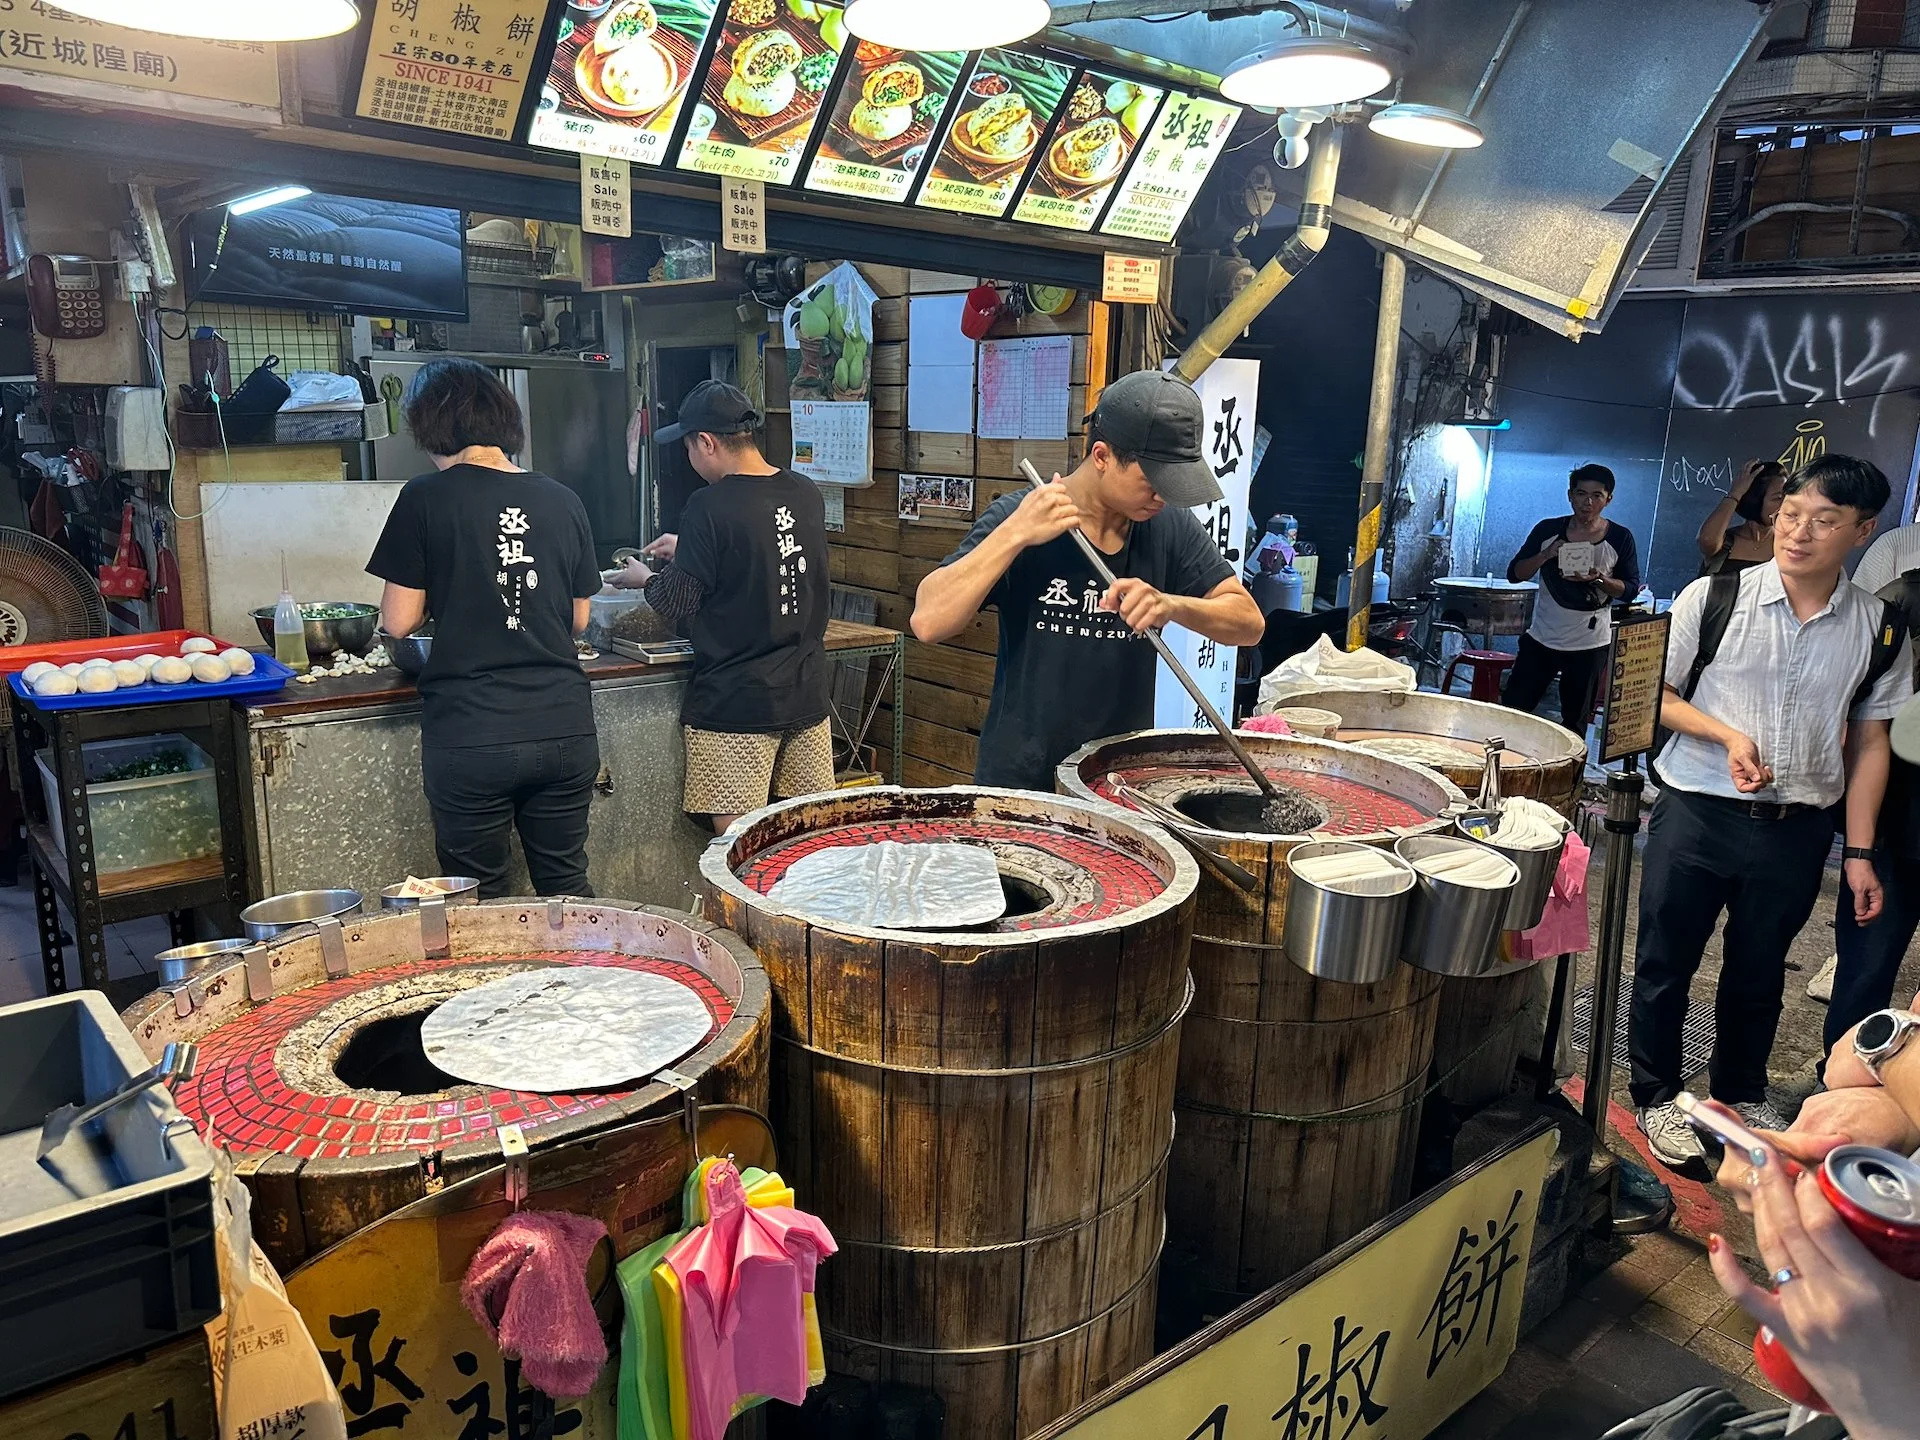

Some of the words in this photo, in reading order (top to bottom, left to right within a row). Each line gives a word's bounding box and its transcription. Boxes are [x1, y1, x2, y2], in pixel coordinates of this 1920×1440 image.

[391, 0, 534, 46] 胡椒餅
[389, 24, 476, 50] CHENG
[495, 46, 525, 60] ZU
[0, 29, 178, 82] (近城隍廟)
[391, 41, 513, 77] 正宗80年老店
[394, 62, 450, 86] SINCE
[454, 75, 493, 94] 1941
[564, 120, 595, 135] 豬肉
[1162, 102, 1213, 150] 丞祖
[709, 145, 736, 159] 牛肉
[590, 167, 621, 182] 販售中
[594, 184, 618, 197] Sale
[730, 188, 757, 202] 販售中
[590, 198, 622, 212] 販売中
[733, 204, 755, 216] Sale
[592, 214, 621, 228] 판매중
[730, 217, 758, 231] 販売中
[732, 232, 757, 245] 판매중
[268, 246, 335, 265] 天然最舒服
[802, 403, 814, 416] 10
[496, 506, 535, 566] 丞祖
[774, 506, 803, 560] 丞祖
[496, 570, 519, 631] 胡餅
[1042, 609, 1081, 620] SINCE
[1184, 1190, 1525, 1440] 椒餅
[237, 1404, 306, 1440] 超厚款
